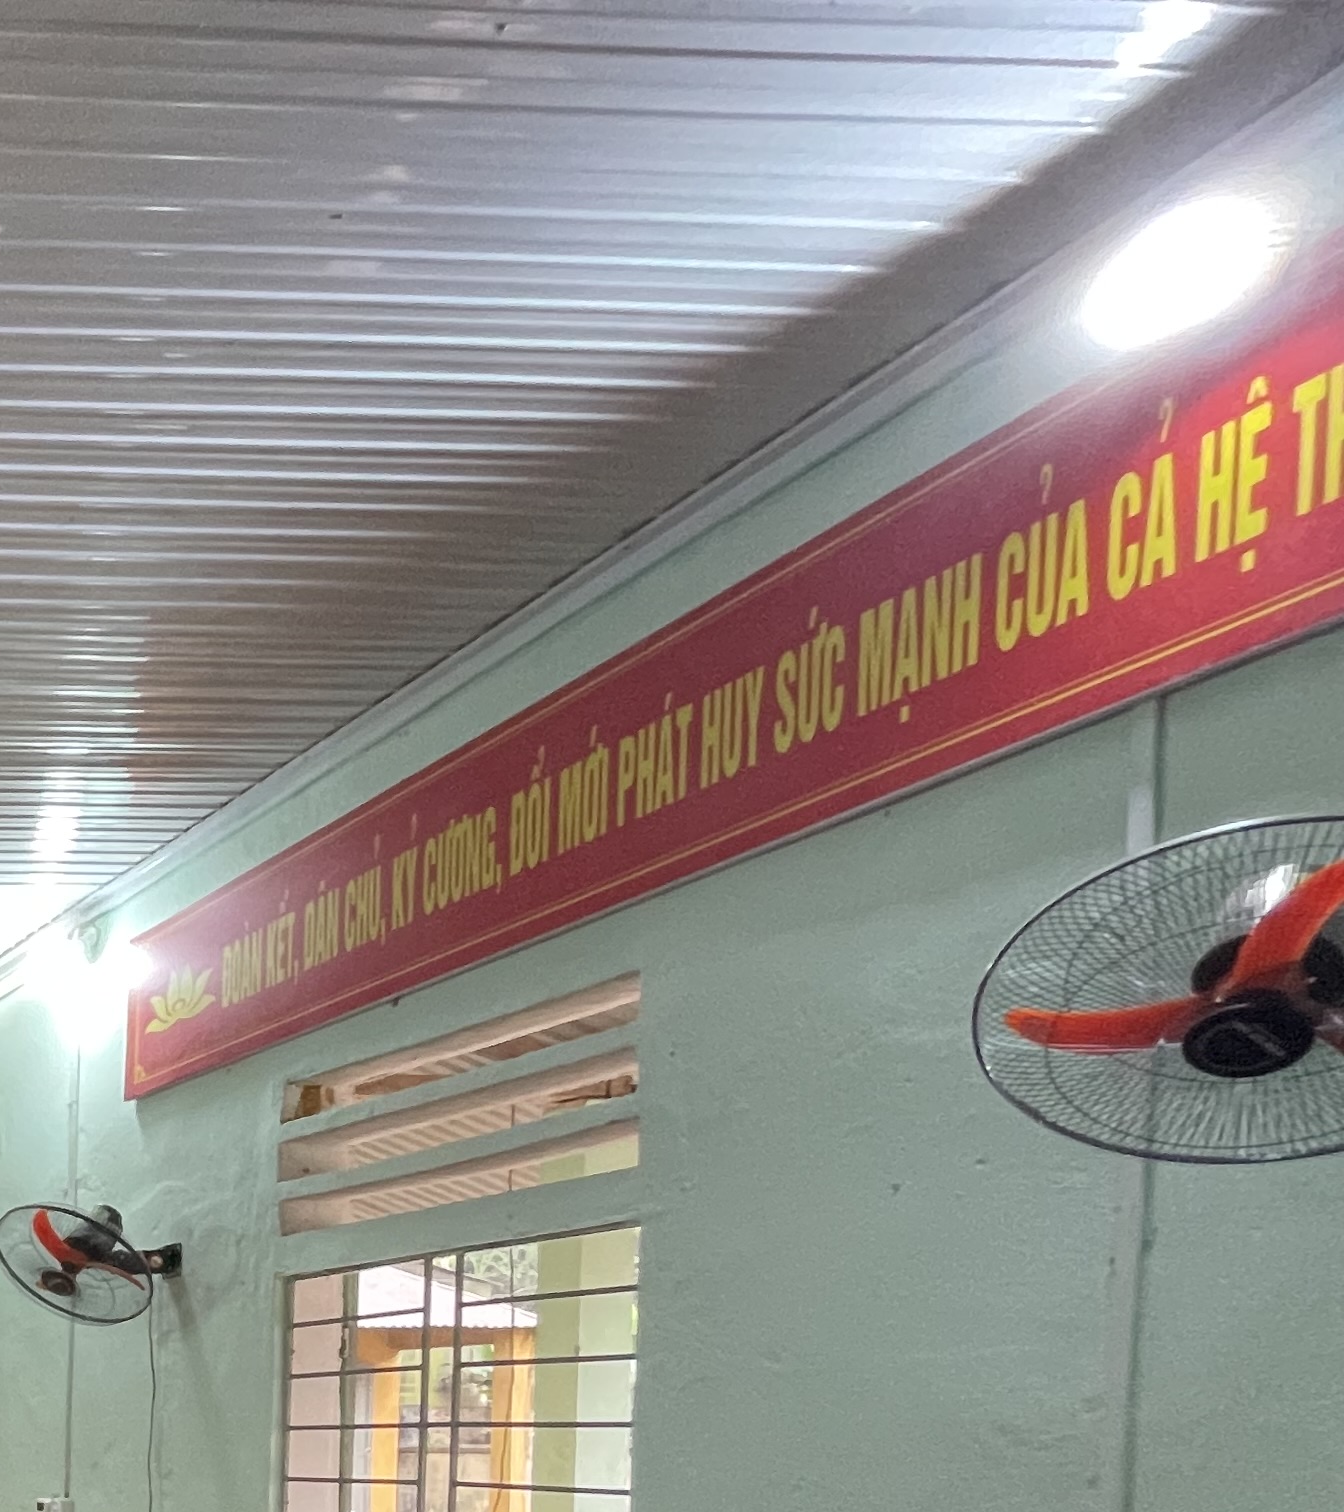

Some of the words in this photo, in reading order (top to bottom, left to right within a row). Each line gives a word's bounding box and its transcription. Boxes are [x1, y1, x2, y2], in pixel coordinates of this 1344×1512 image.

[221, 921, 262, 1008] ĐOÀN
[304, 880, 340, 971] DÂN
[344, 833, 386, 952] CHỦ,
[391, 813, 418, 930] KỶ
[423, 806, 502, 916] CƯƠNG,
[509, 746, 551, 876] ĐỔI
[558, 725, 609, 856] MỚI
[617, 692, 693, 827] PHÁT
[699, 665, 765, 789] HUY
[774, 606, 846, 754] SỨC
[857, 552, 984, 722] MẠNH
[995, 464, 1090, 653] CỦA
[1107, 398, 1177, 601] CẢ
[1196, 375, 1273, 572] HỆ
